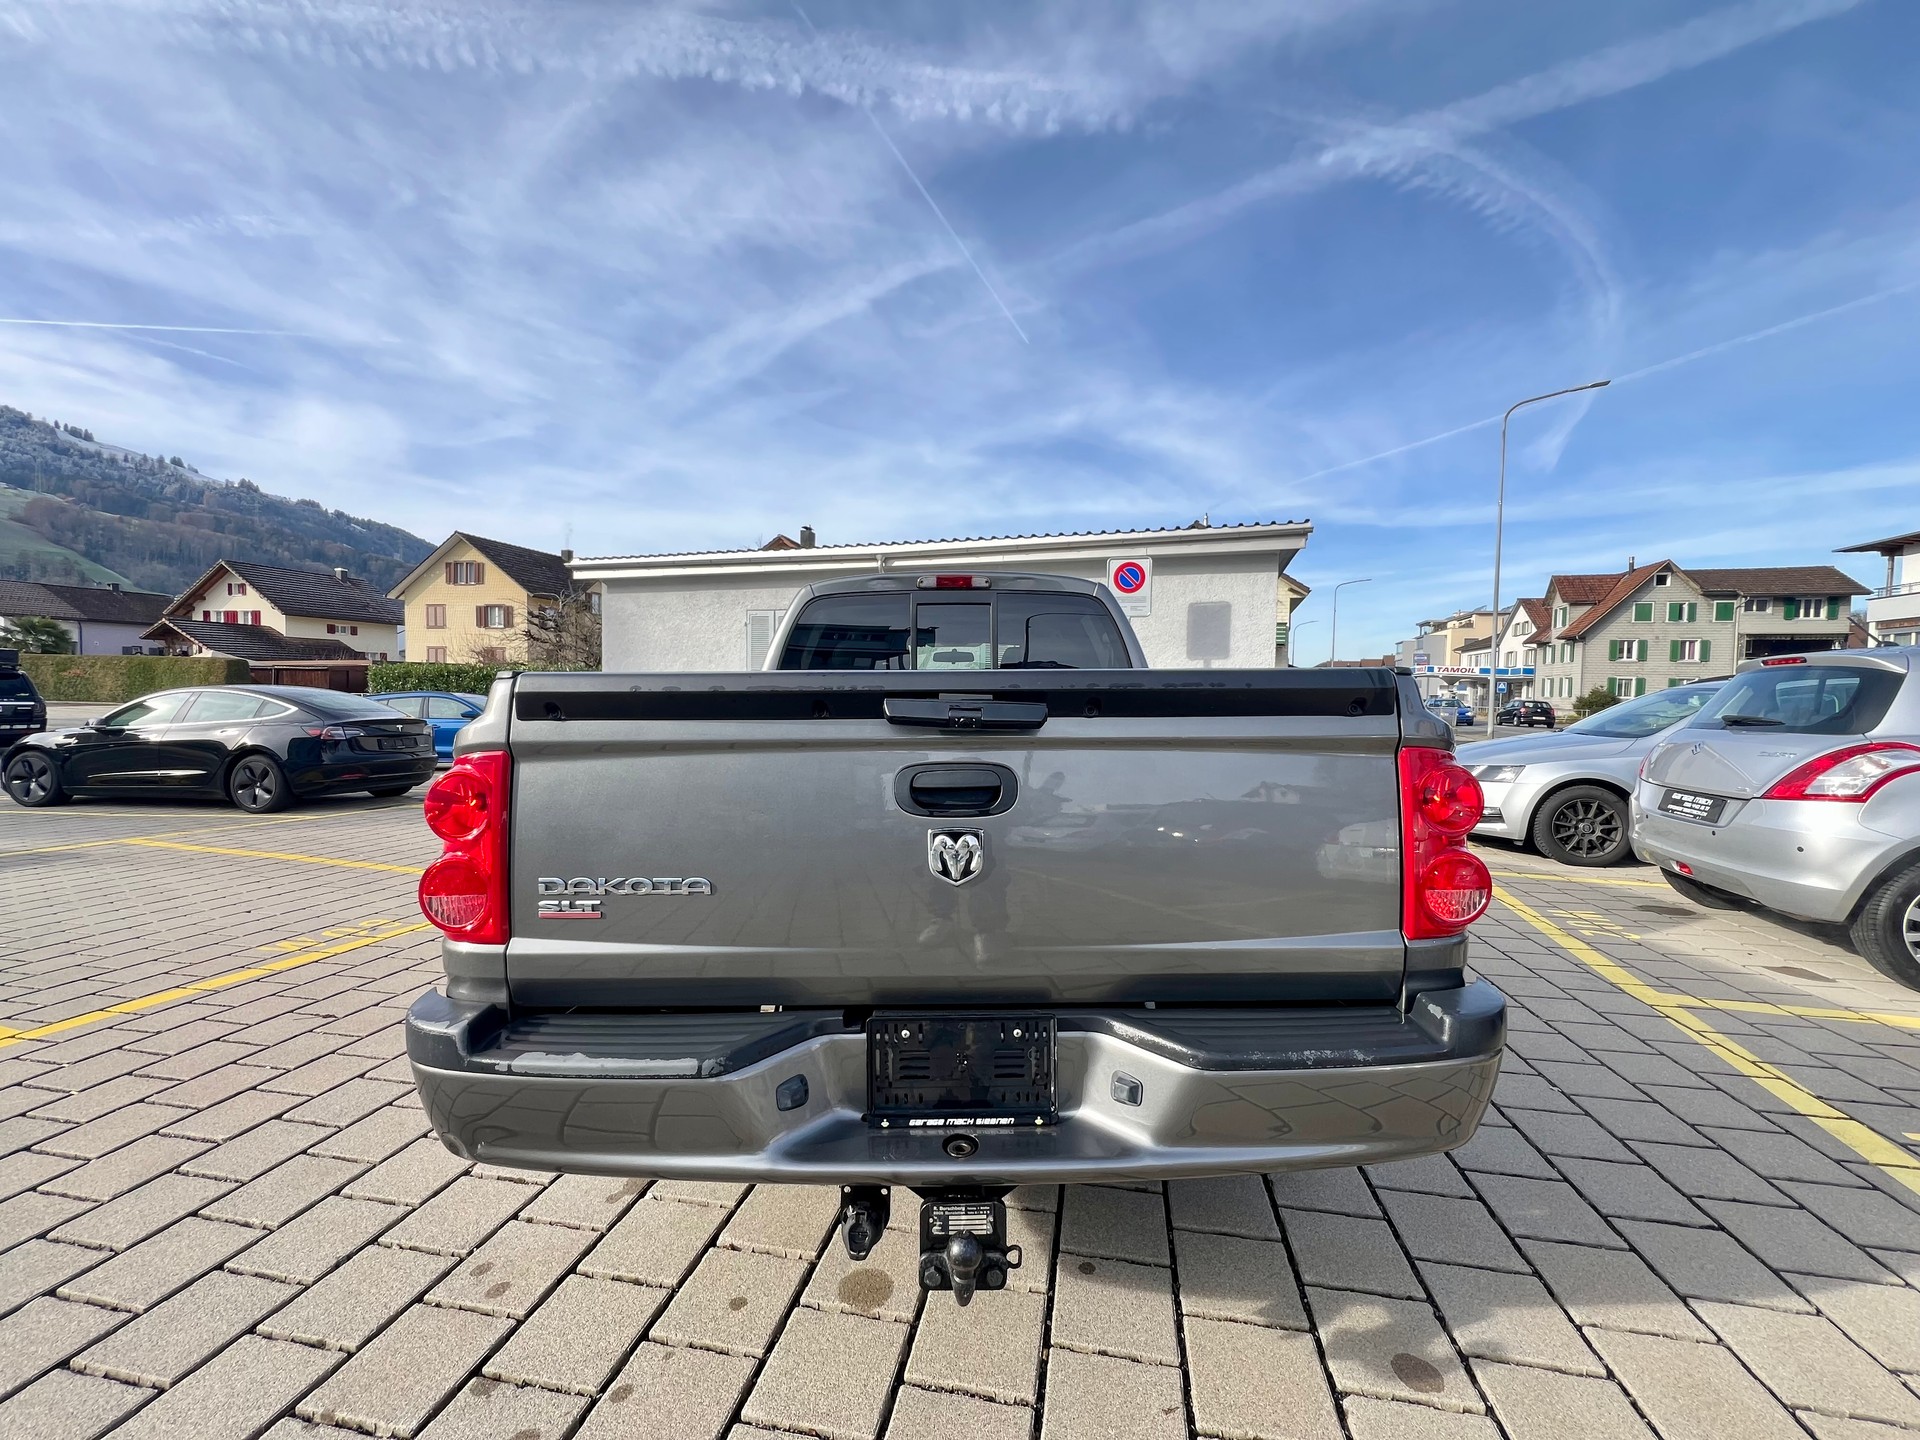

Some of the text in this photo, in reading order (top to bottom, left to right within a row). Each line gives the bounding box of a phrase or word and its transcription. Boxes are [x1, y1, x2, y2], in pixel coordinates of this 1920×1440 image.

[1436, 666, 1477, 674] TAMOIL
[538, 877, 712, 895] DAKOTA
[538, 900, 602, 912] SLT
